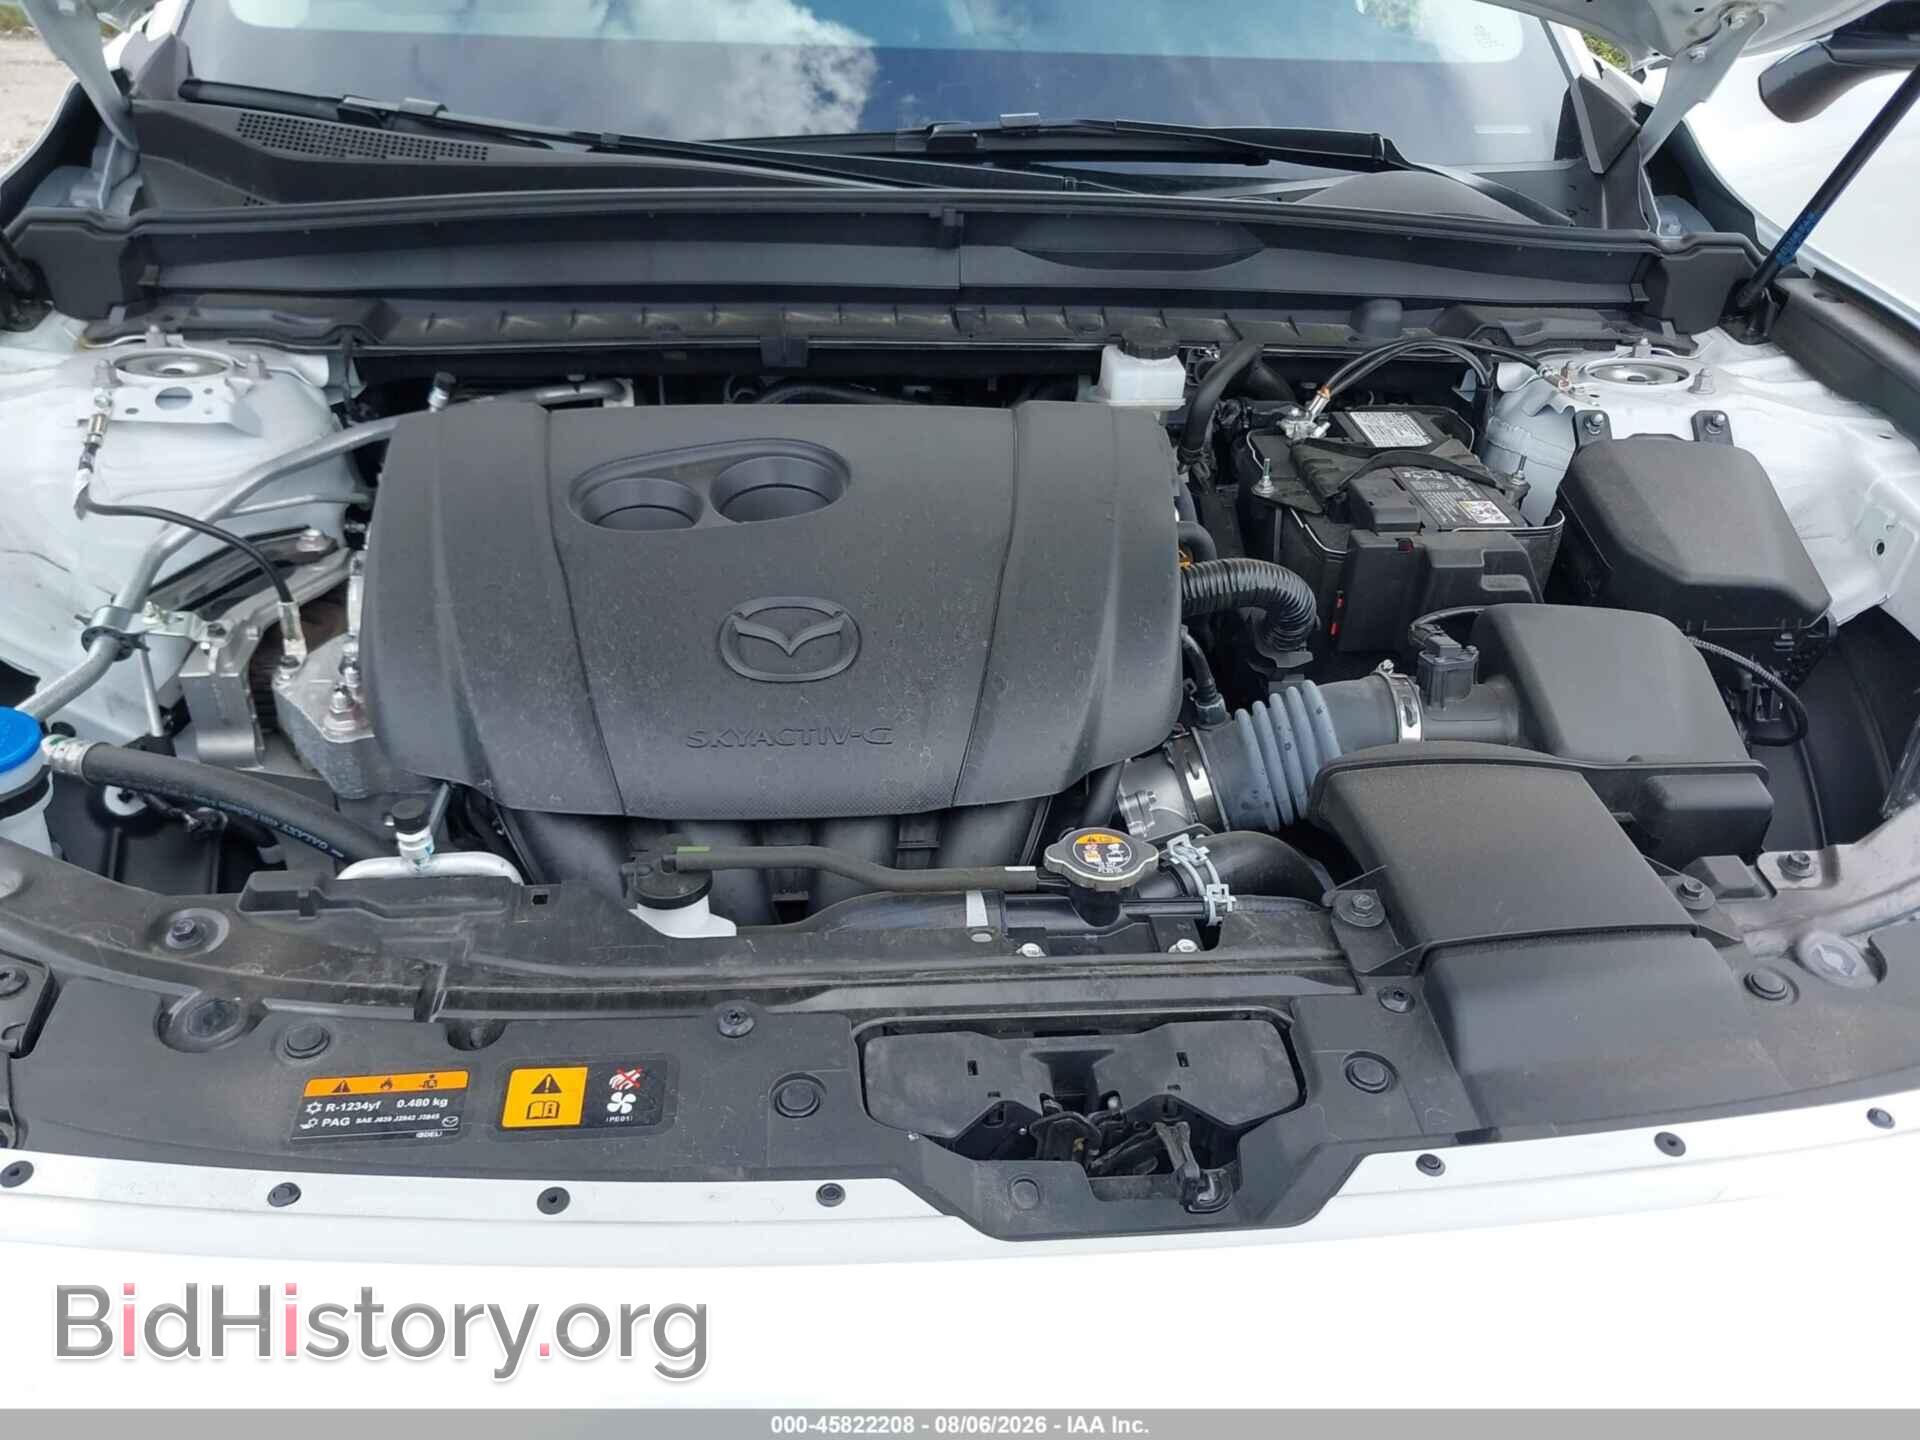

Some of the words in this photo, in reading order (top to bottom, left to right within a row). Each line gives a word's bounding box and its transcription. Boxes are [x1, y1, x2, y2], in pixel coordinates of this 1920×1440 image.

[325, 1101, 381, 1114] R-1234yf
[396, 1098, 430, 1109] 0.480
[432, 1097, 449, 1108] kg
[321, 1117, 351, 1128] PAG
